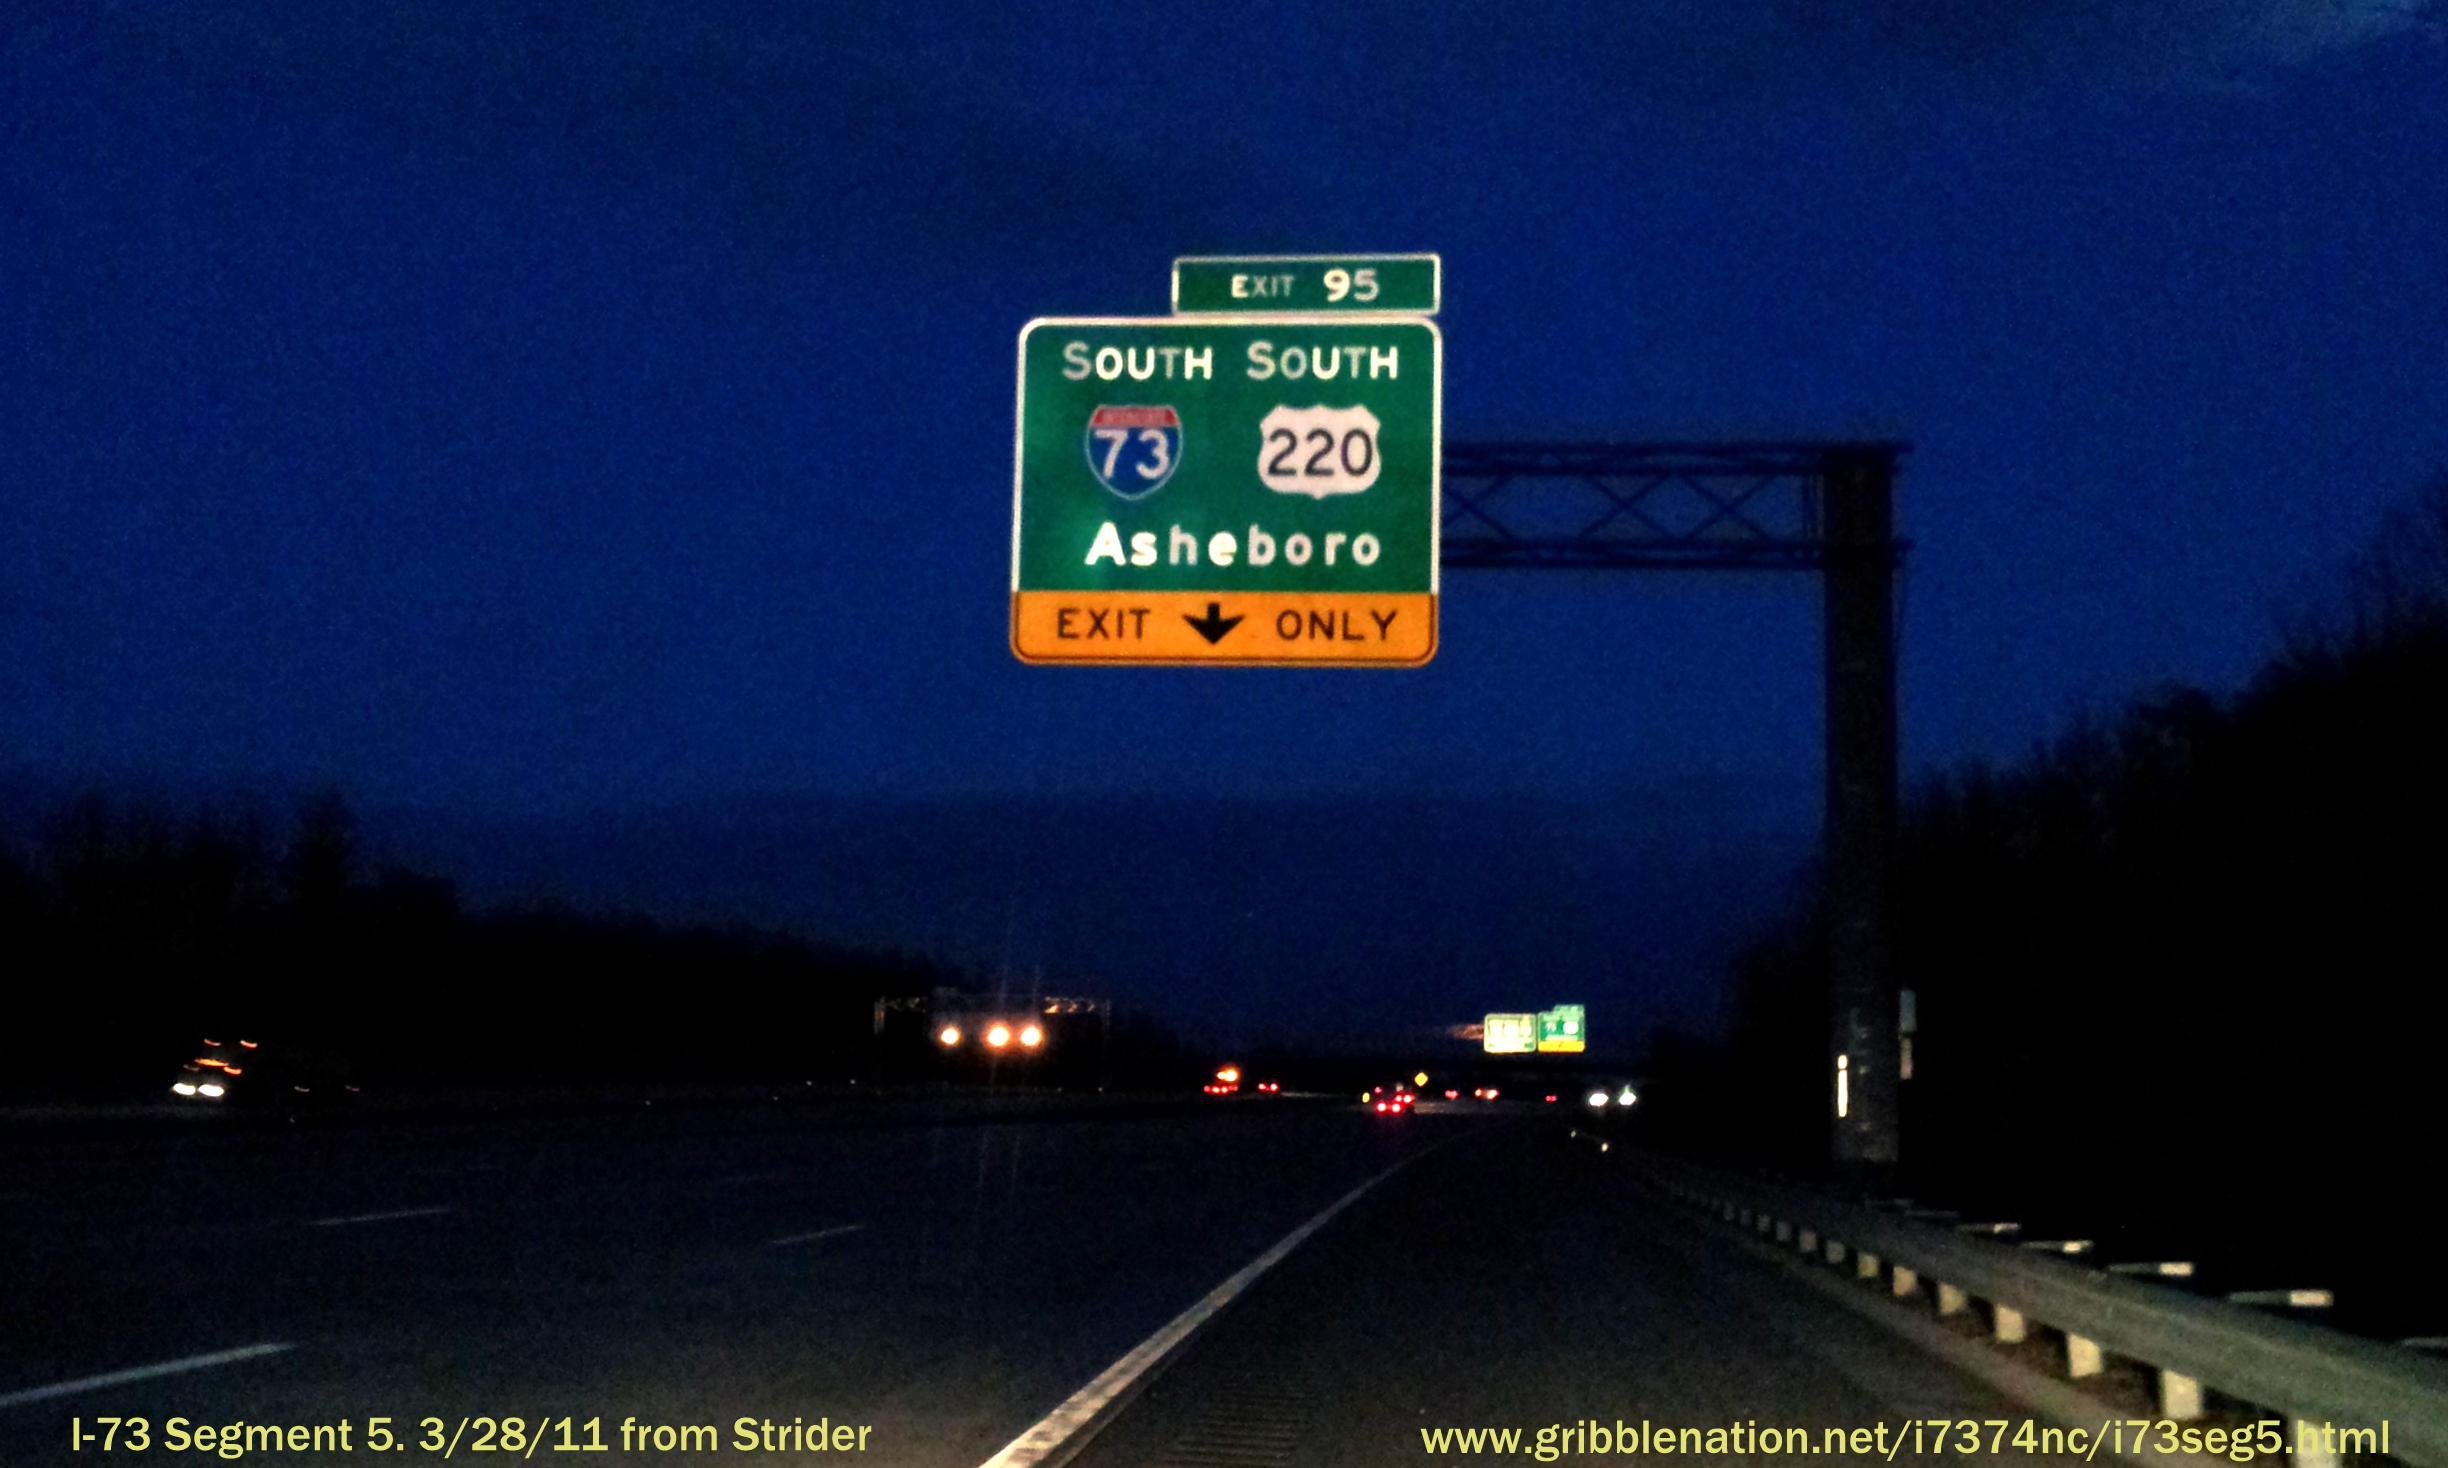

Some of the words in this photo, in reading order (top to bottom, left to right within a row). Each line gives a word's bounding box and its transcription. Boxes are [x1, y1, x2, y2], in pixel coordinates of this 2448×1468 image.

[1231, 274, 1294, 299] EXIT
[1323, 268, 1380, 302] 95
[1062, 342, 1214, 381] SOUTH
[1247, 341, 1398, 380] SOUTH
[1095, 429, 1170, 480] 73
[1267, 428, 1374, 478] 220
[1085, 522, 1382, 566] Asheboro
[1057, 608, 1150, 638] EXIT
[1276, 610, 1398, 641] ONLY
